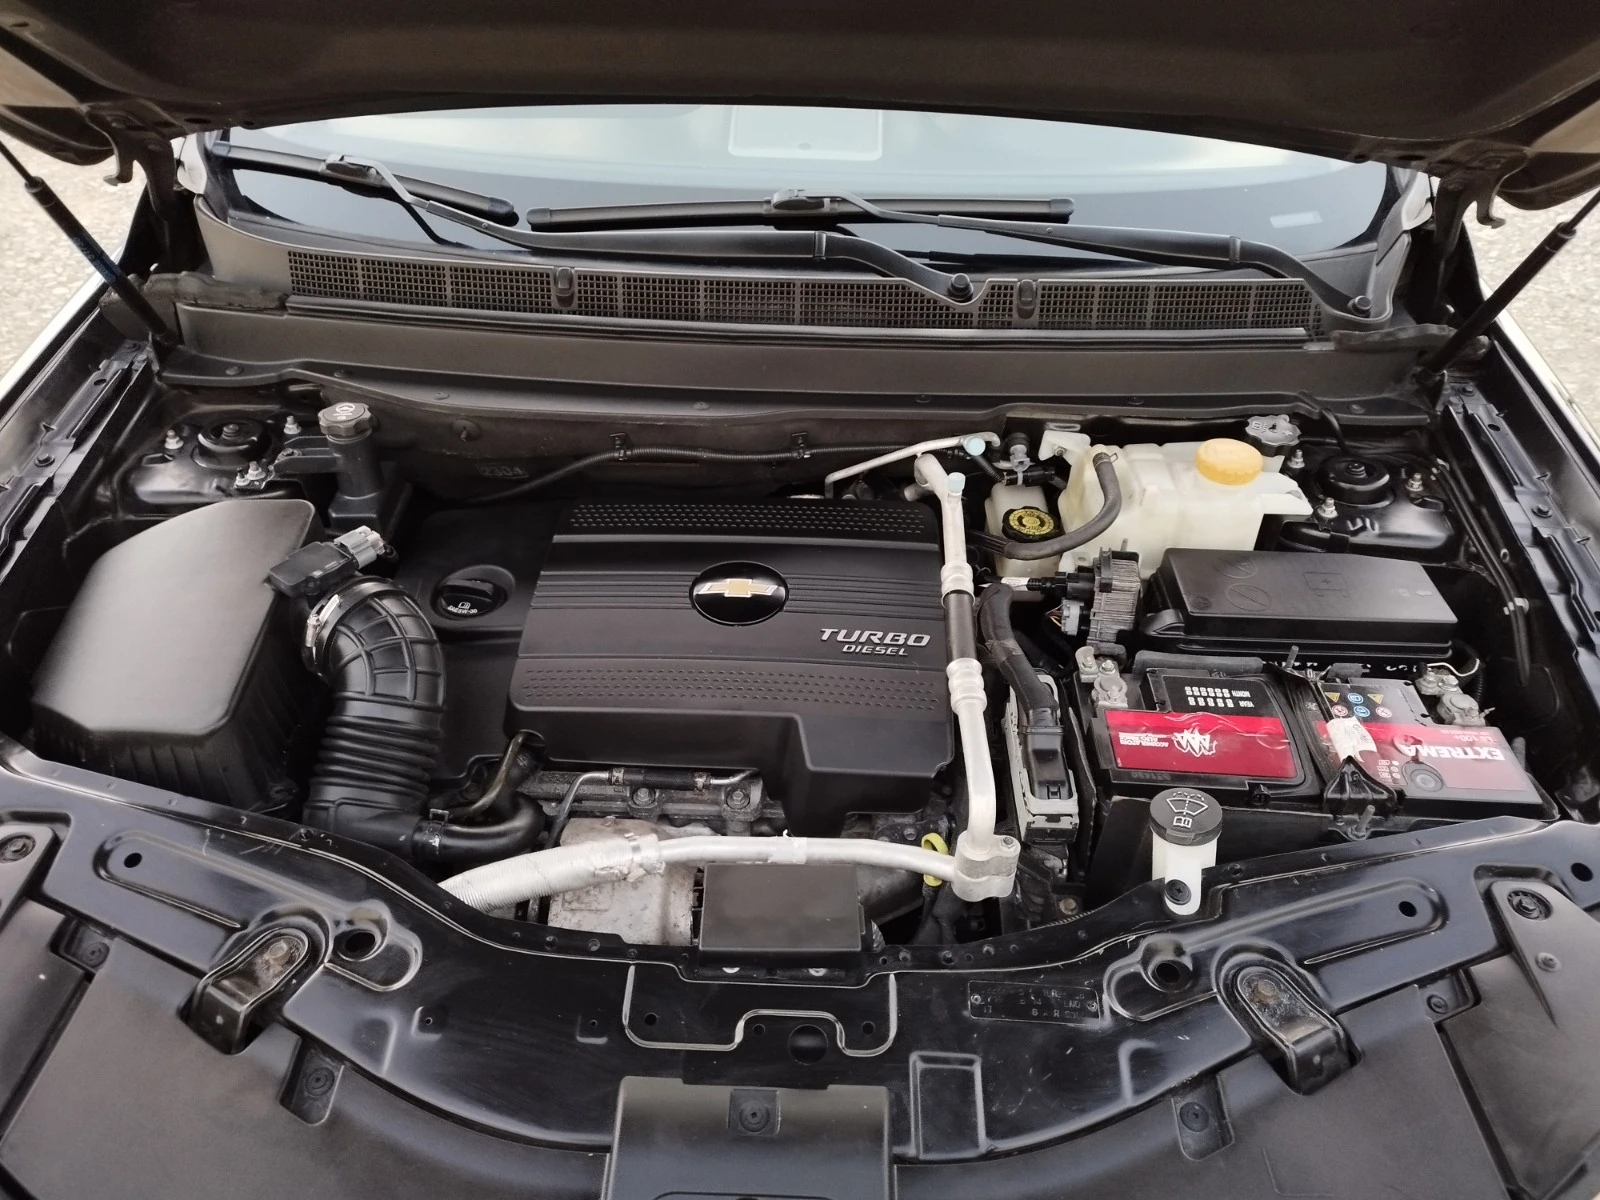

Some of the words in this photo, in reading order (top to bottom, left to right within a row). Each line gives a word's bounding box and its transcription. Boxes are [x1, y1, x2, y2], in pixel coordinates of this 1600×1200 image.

[820, 628, 931, 647] TURBO
[842, 644, 909, 657] DIESEL
[1238, 700, 1255, 708] YEAR
[1400, 744, 1505, 760] EXTREMA
